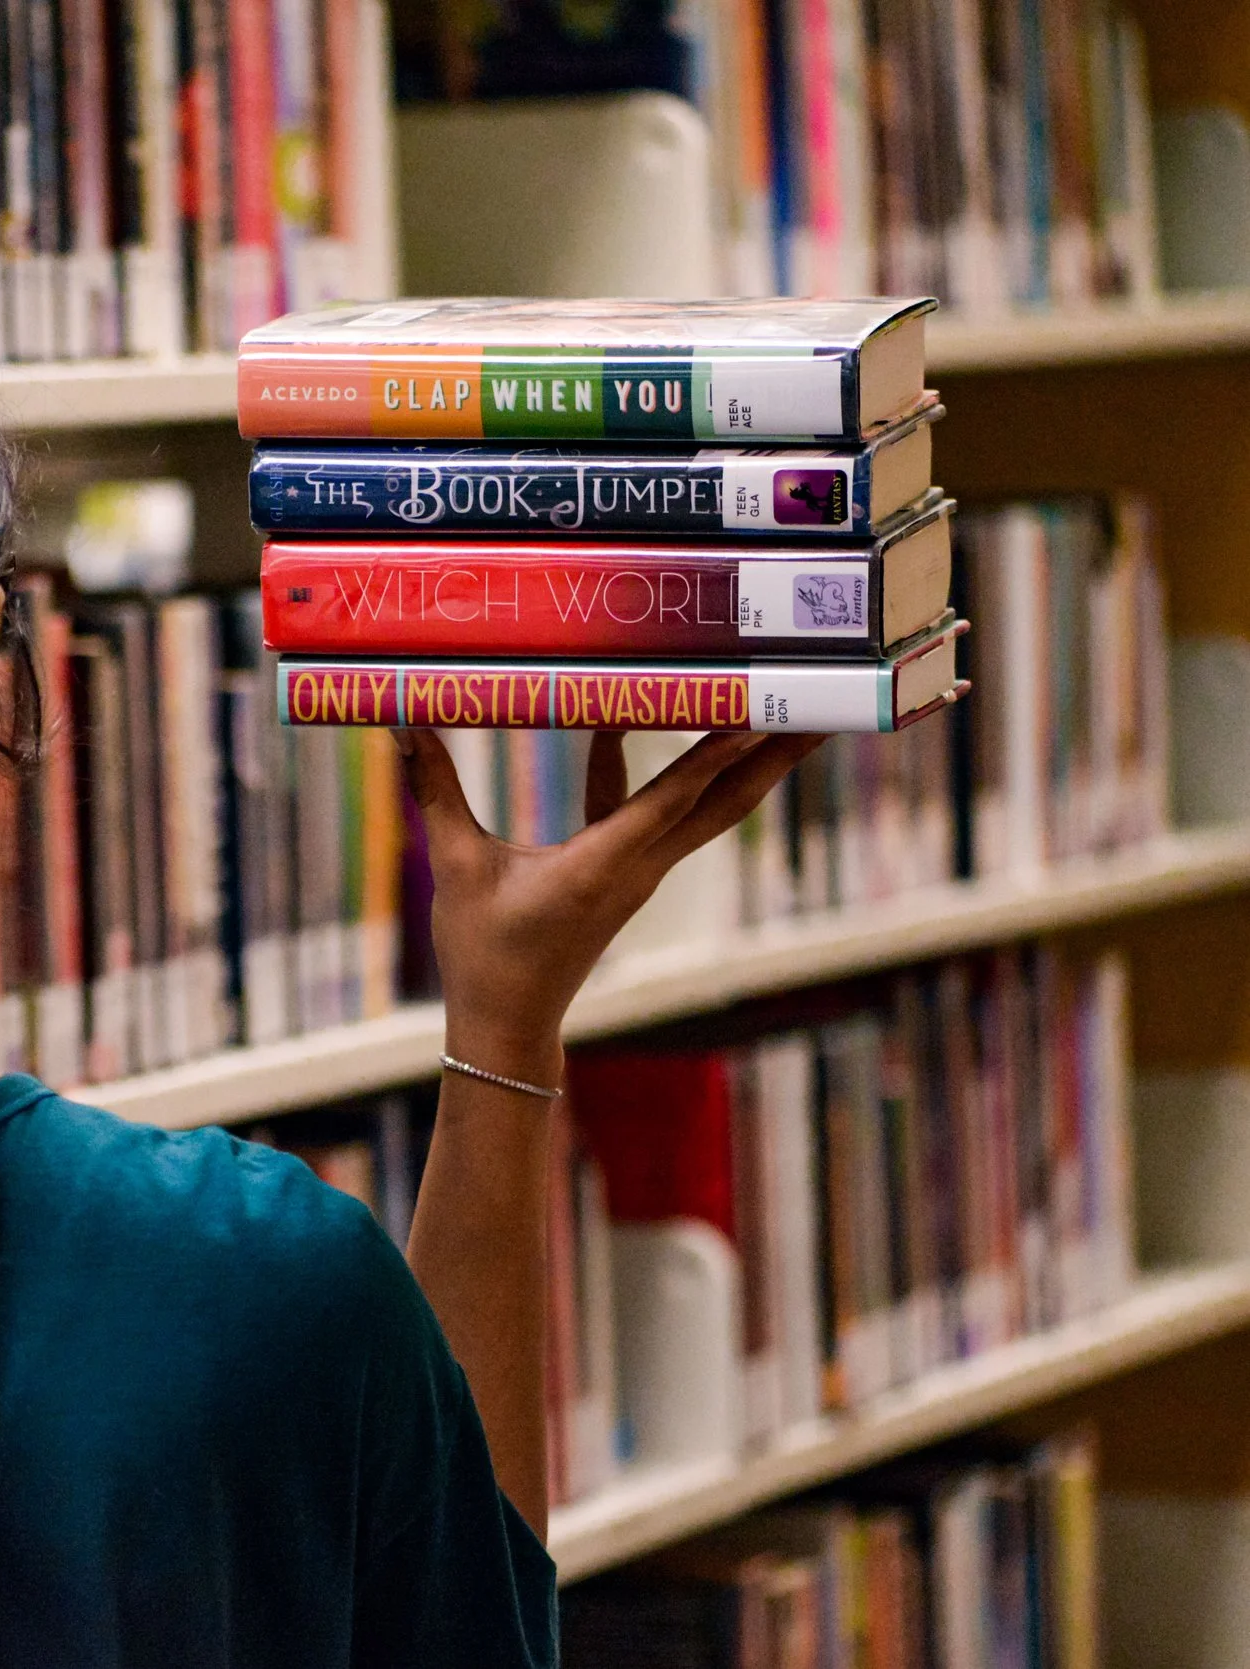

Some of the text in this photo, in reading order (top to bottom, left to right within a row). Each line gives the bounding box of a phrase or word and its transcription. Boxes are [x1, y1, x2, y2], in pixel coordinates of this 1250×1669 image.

[260, 385, 358, 402] ACEVEDO
[383, 378, 472, 411] CLAP
[491, 378, 594, 413] WHEN
[614, 379, 683, 414] YOU
[729, 398, 740, 429] TEEN
[742, 406, 753, 429] ACE
[304, 464, 375, 519] THE
[388, 464, 539, 525] BOOK
[736, 487, 747, 517] TEEN
[750, 494, 760, 518] GLA
[833, 475, 843, 521] FANTASY
[334, 569, 739, 624] WITCH WORL
[852, 576, 865, 626] Fantasy
[740, 597, 750, 629] TEEN
[753, 609, 764, 629] PIK
[293, 672, 749, 727] ONLY MOSTLY DEVASTATED
[765, 693, 774, 724] TEEN
[778, 698, 789, 724] GON
